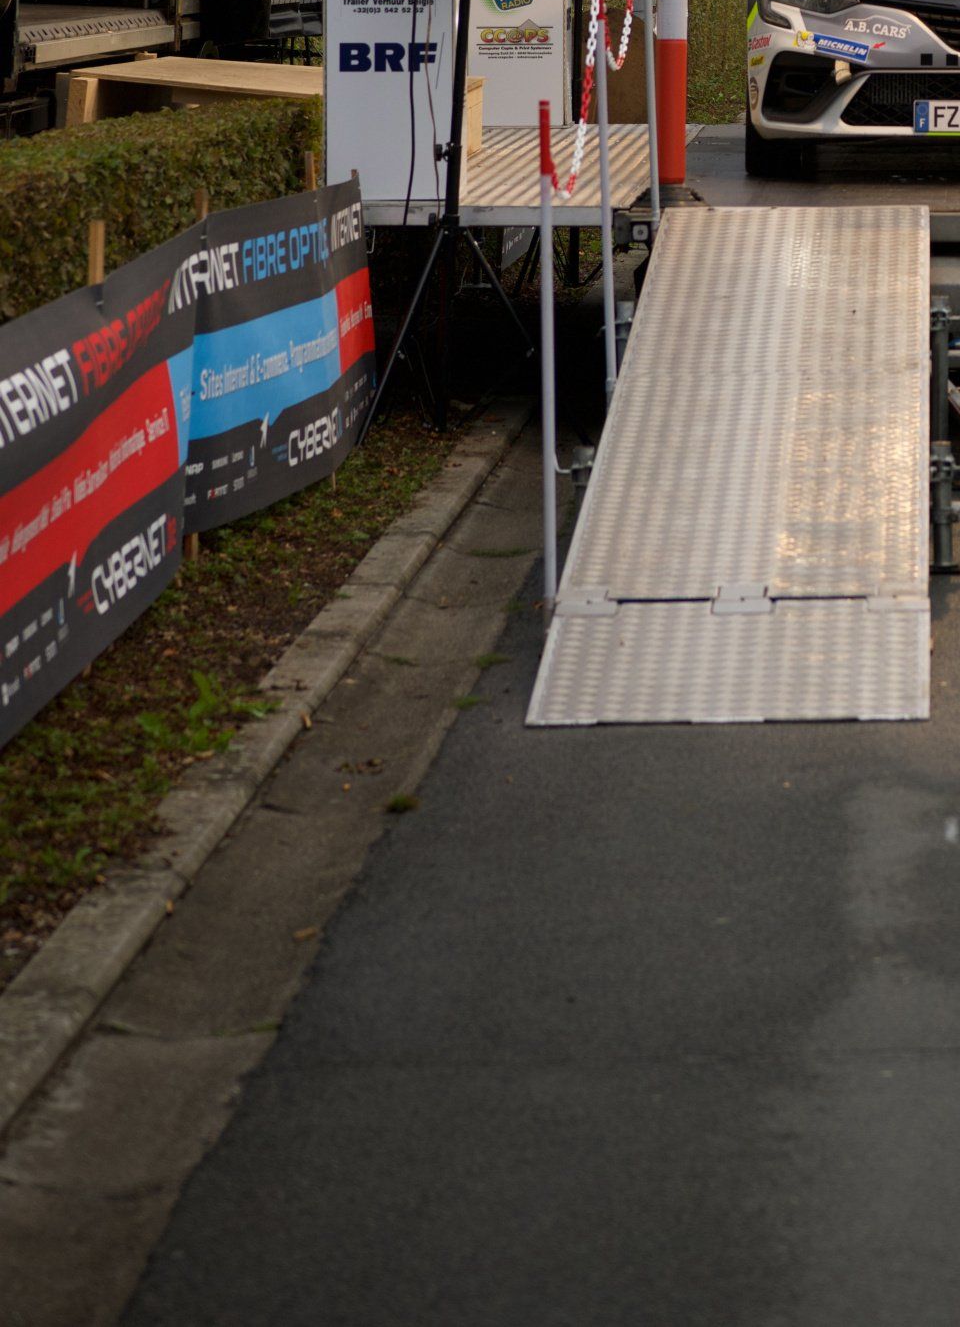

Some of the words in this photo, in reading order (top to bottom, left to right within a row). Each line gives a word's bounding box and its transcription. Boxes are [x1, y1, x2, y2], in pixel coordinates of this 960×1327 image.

[844, 20, 870, 32] A.B.
[872, 23, 908, 39] CARS
[818, 39, 868, 56] MICHELIN
[339, 42, 437, 73] BRF
[919, 118, 926, 128] F
[242, 231, 287, 284] FIBRE
